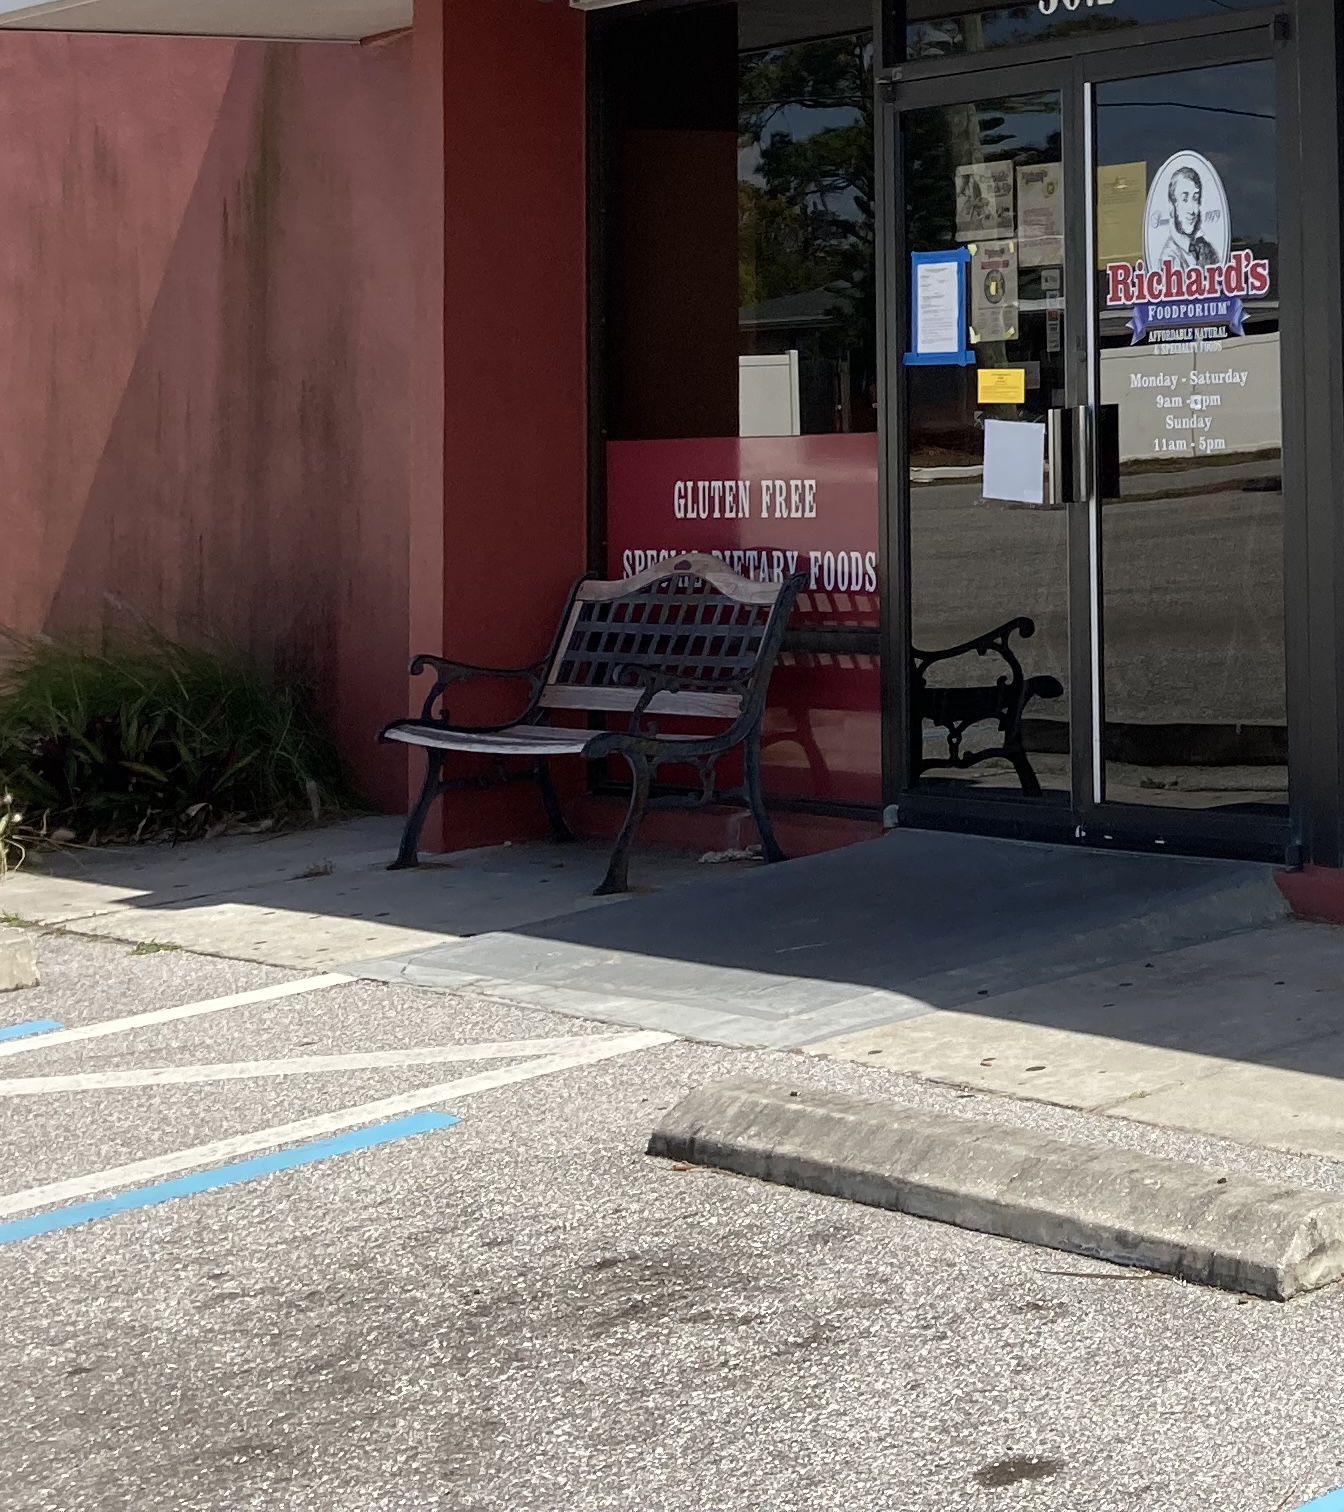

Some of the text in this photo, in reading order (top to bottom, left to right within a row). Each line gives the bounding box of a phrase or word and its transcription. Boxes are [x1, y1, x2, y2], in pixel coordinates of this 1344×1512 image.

[1107, 251, 1270, 304] Richard's
[1130, 373, 1178, 390] Monday
[1189, 369, 1249, 387] Saturday
[1156, 395, 1182, 408] 9am
[1166, 414, 1213, 431] Sunday
[1154, 438, 1187, 451] 11am
[1199, 437, 1226, 453] 5pm
[673, 479, 817, 519] GLUTEN FREE
[809, 550, 877, 593] FOODS
